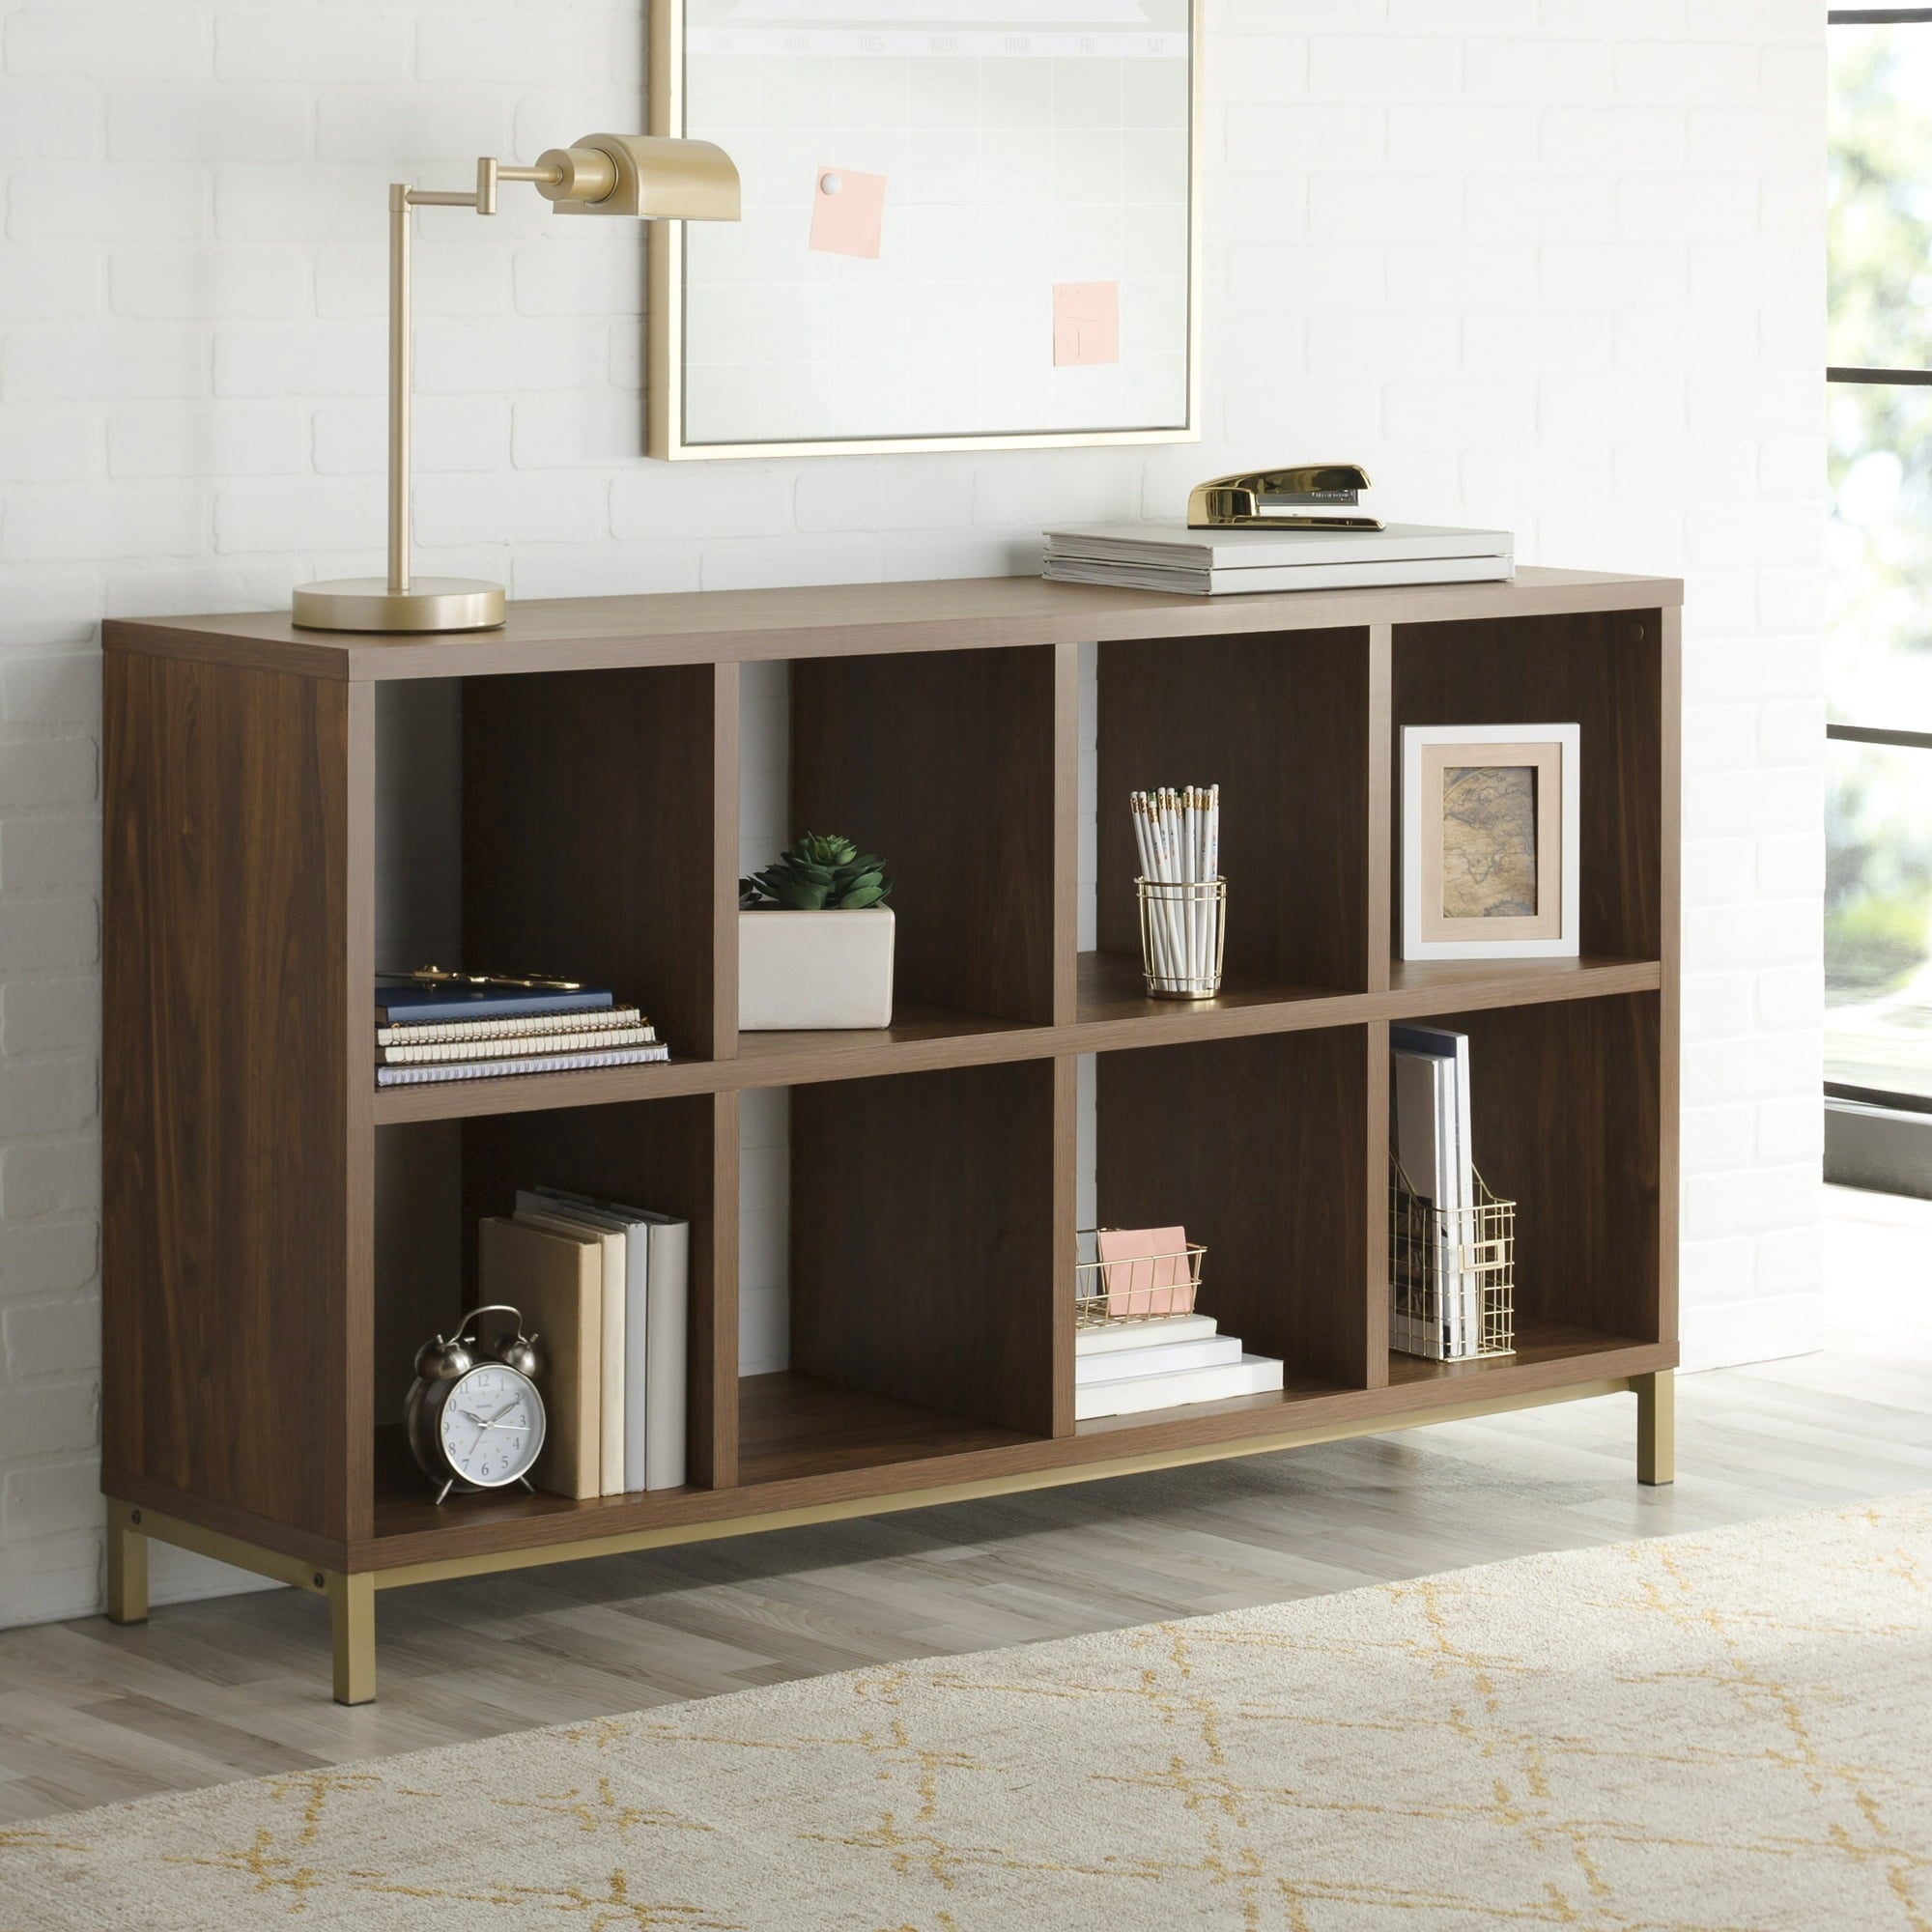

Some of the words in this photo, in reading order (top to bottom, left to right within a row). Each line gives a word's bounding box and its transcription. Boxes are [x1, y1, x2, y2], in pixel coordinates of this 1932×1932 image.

[859, 34, 885, 52] TUES
[929, 37, 958, 54] WEDS
[1005, 37, 1031, 54] THUR
[1079, 38, 1095, 54] FRI
[1148, 38, 1164, 54] SAT
[478, 1374, 489, 1387] 12
[500, 1378, 505, 1391] 1
[459, 1381, 469, 1394] 11
[514, 1392, 521, 1405] 2
[520, 1414, 526, 1428] 3
[448, 1442, 456, 1456] 8
[512, 1436, 521, 1450] 4
[462, 1459, 469, 1472] 7
[501, 1455, 509, 1468] 5
[481, 1463, 489, 1476] 6
